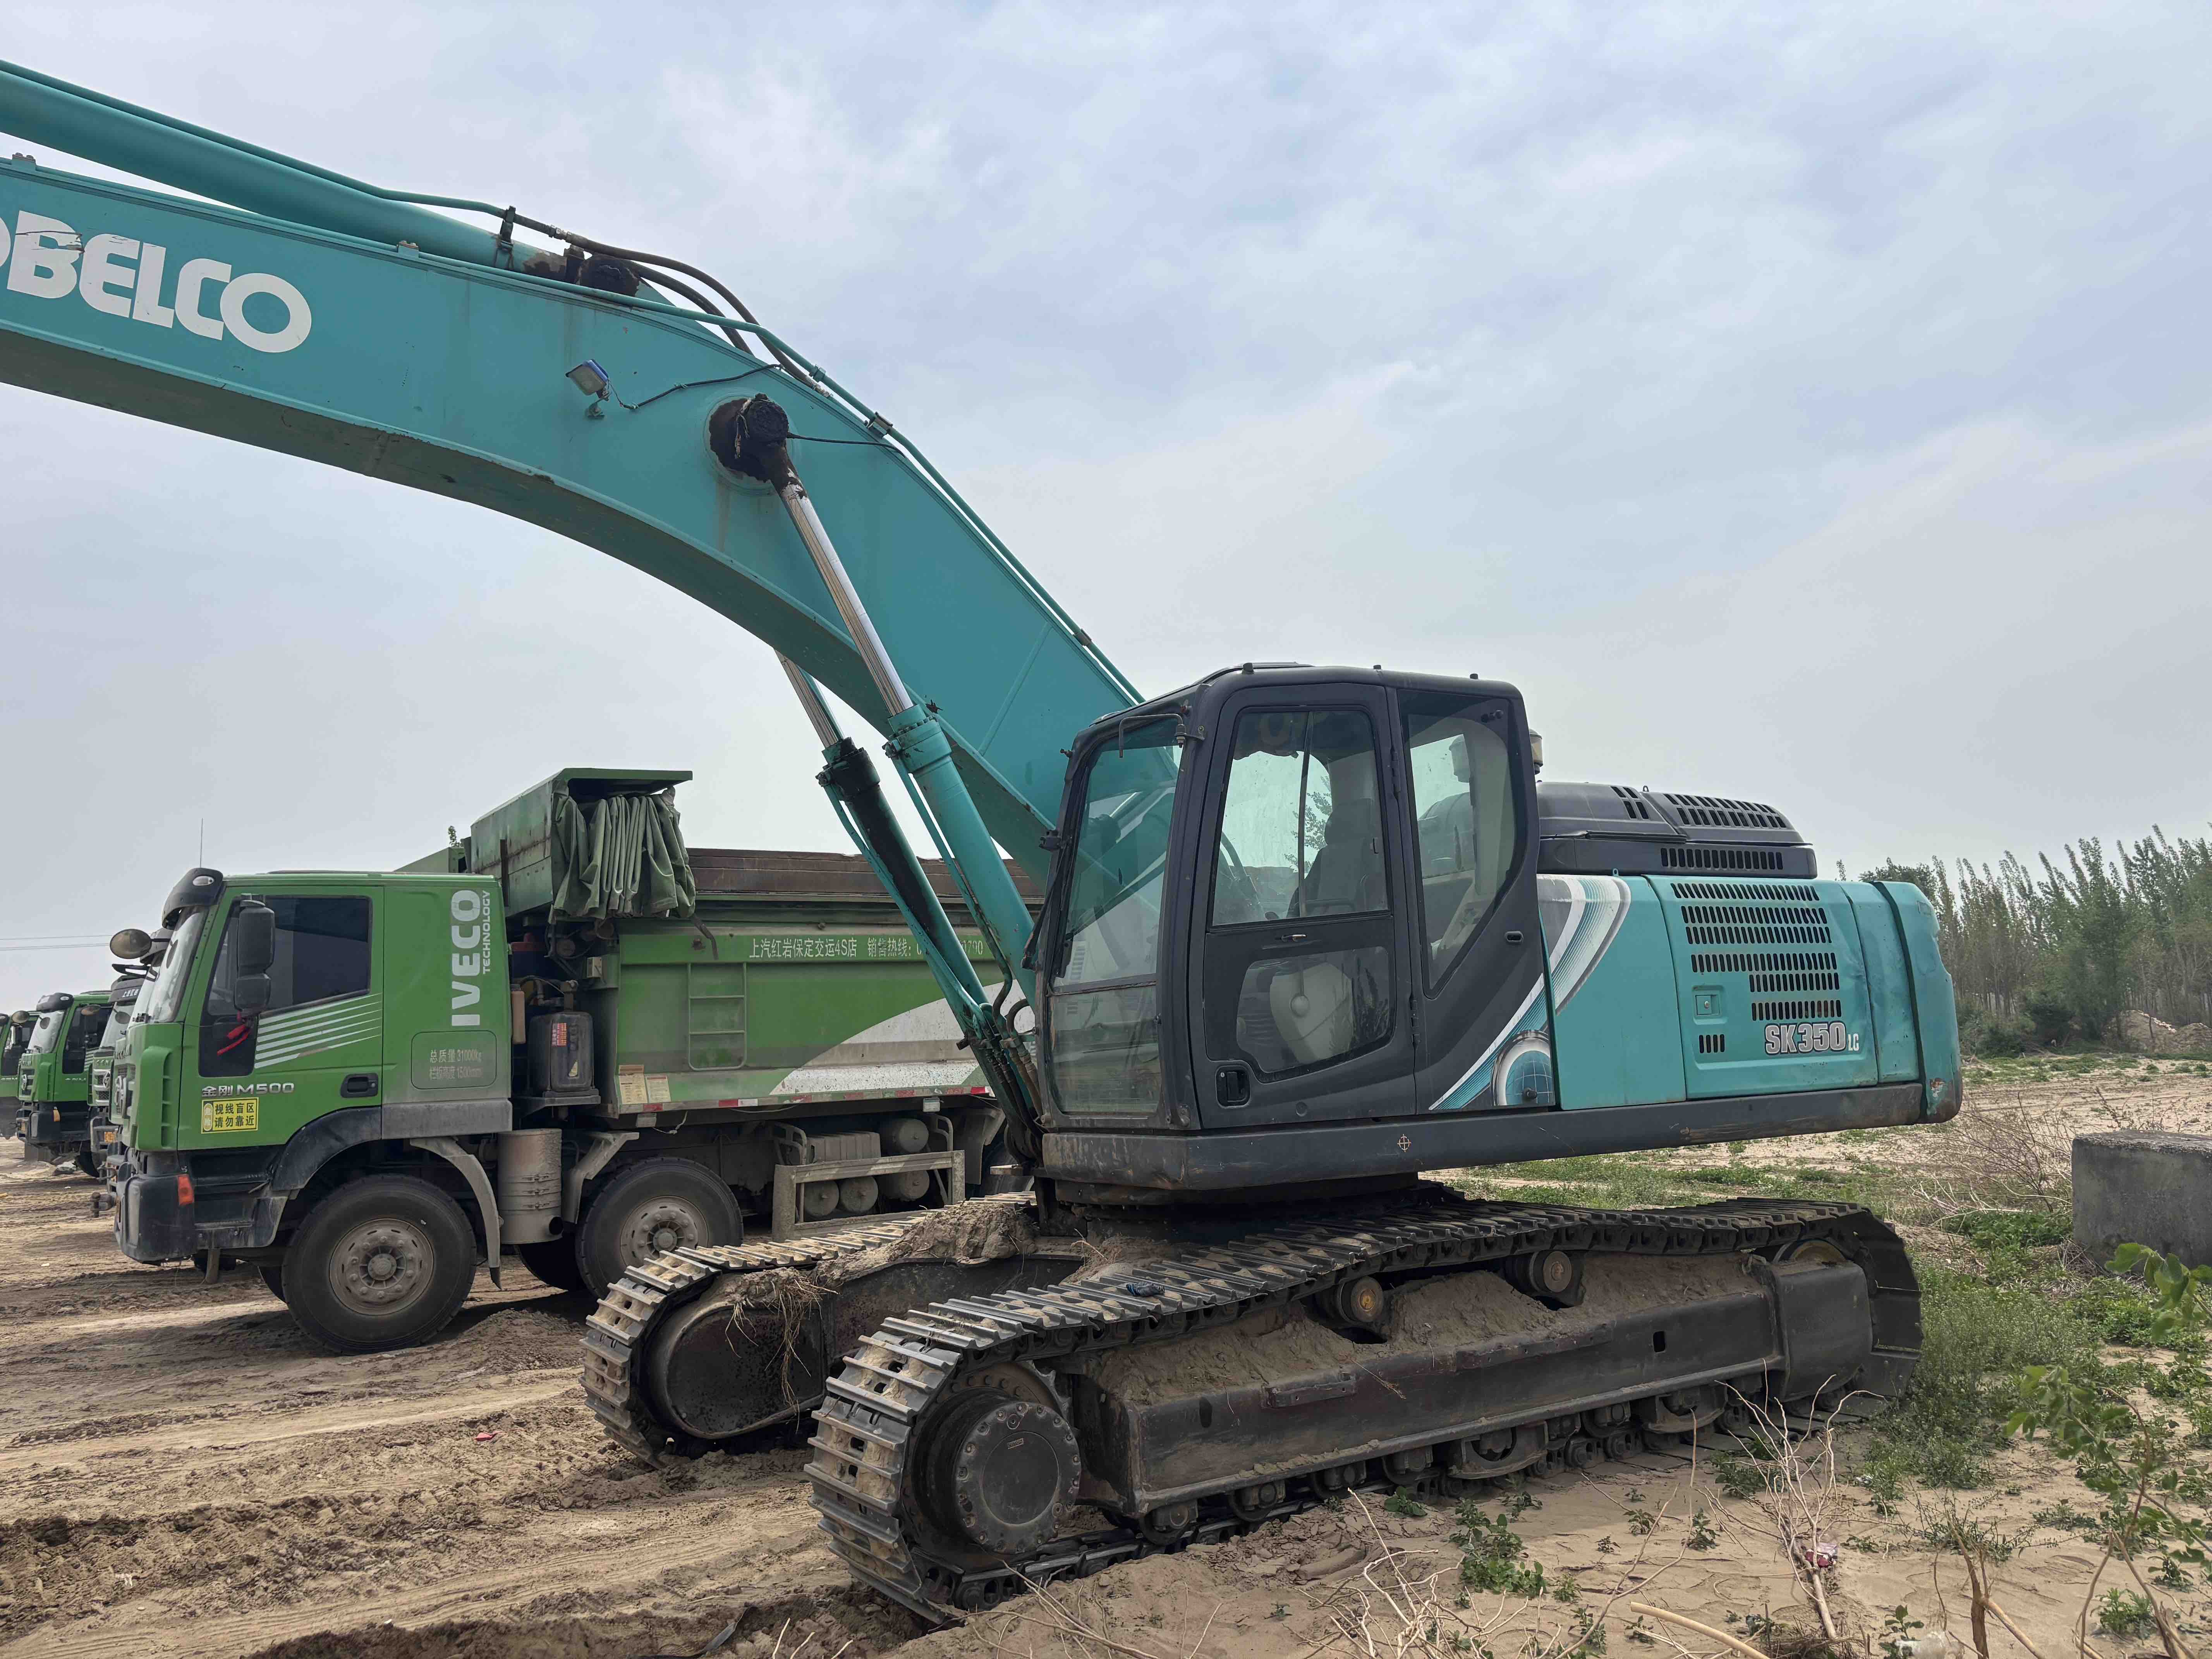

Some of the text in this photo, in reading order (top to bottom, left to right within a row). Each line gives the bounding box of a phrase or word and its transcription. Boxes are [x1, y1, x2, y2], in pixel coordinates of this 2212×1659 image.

[0, 210, 311, 353] BELCO
[483, 890, 491, 974] TECHNOLOGY
[451, 890, 480, 1026] IVECO
[749, 937, 857, 958] 上汽红岩保定交运4S店
[1765, 1020, 1859, 1055] SK350 LC
[202, 1082, 294, 1097] 金刚 M500
[215, 1103, 254, 1115] 视线盲区
[215, 1115, 254, 1128] 请勿靠近
